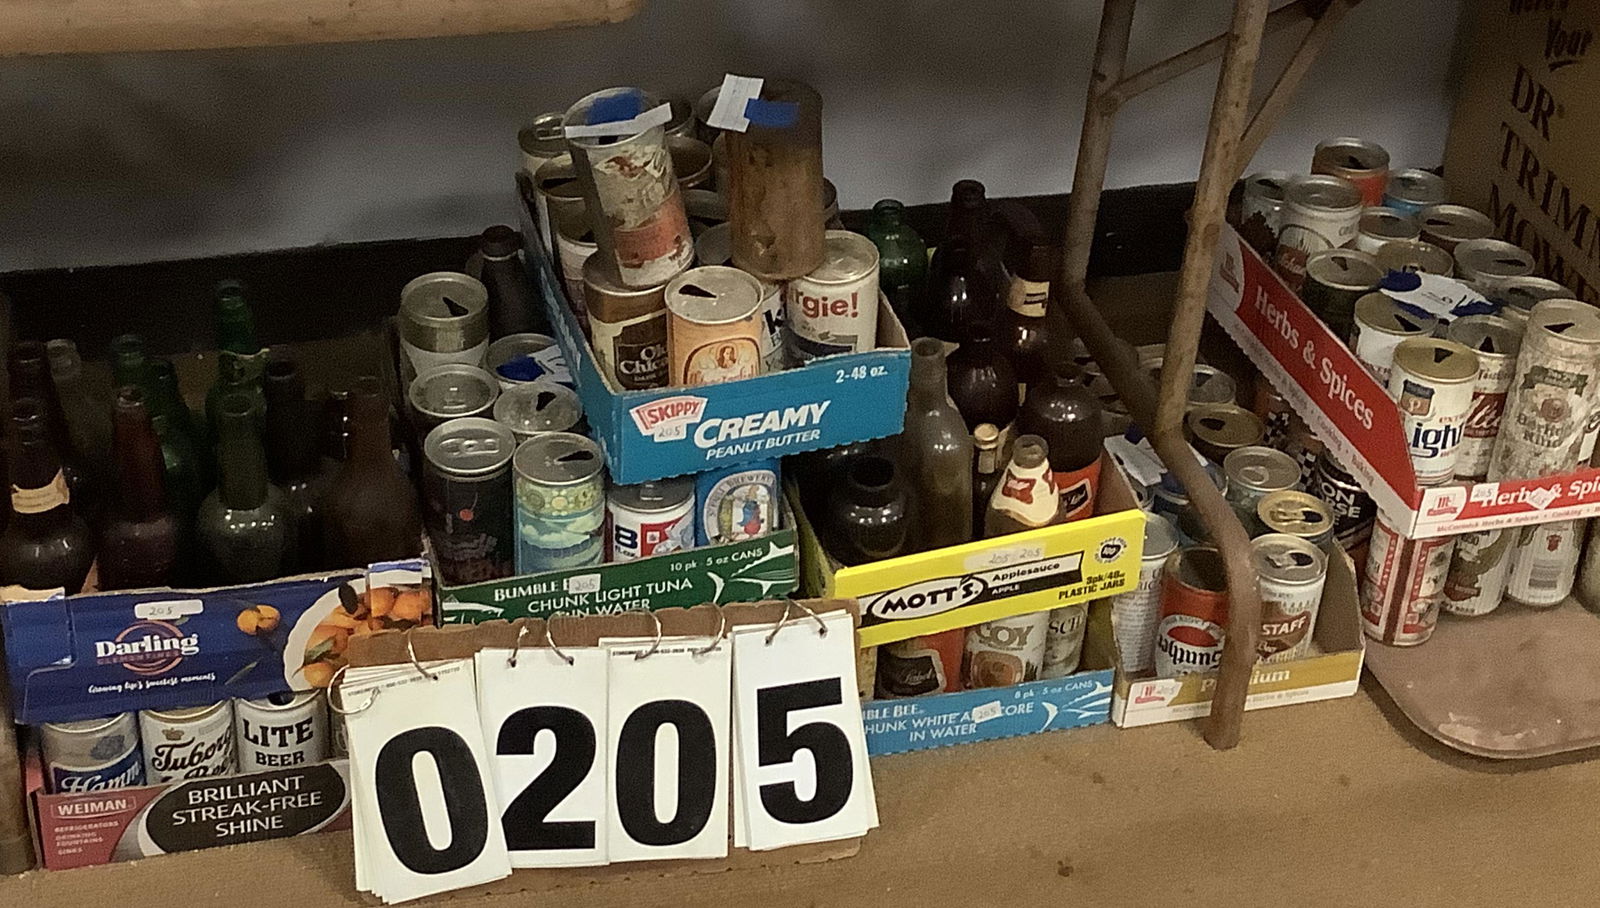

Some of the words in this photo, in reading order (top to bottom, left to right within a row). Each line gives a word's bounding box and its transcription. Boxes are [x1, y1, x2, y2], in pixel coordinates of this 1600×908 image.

[1511, 63, 1555, 142] DR
[1254, 285, 1299, 349] Herbs
[1303, 340, 1316, 369] &
[1319, 357, 1374, 430] Spices
[835, 366, 867, 383] 2-48
[647, 400, 700, 425] SKIPPY
[658, 426, 681, 438] 205
[693, 400, 831, 449] CREAMY
[705, 438, 766, 460] PEANUT
[765, 429, 821, 449] BUTTER
[1411, 422, 1464, 459] ight
[1482, 485, 1534, 508] Herb
[1568, 476, 1600, 501] Spi
[615, 525, 638, 549] 8
[670, 562, 682, 571] 10
[685, 560, 697, 572] pk
[706, 557, 713, 566] 5
[716, 556, 729, 565] oz
[731, 547, 763, 562] CANS
[1019, 548, 1041, 559] 205
[992, 562, 1060, 582] Applesauce
[494, 580, 559, 602] BUMBLE
[528, 593, 590, 613] CHUNK
[595, 585, 643, 603] LIGHT
[646, 578, 693, 595] TUNA
[573, 580, 596, 591] 205
[992, 584, 1020, 595] APPLE
[1059, 585, 1097, 600] PLASTIC
[1100, 578, 1125, 590] JARS
[149, 606, 174, 616] 205
[1262, 616, 1307, 636] STAFF
[94, 633, 200, 658] Darling
[88, 681, 122, 693] Growing
[181, 672, 216, 683] moments
[1023, 689, 1034, 700] pk
[1043, 687, 1049, 696] 5
[1064, 680, 1093, 692] CANS
[242, 716, 314, 748] LITE
[866, 720, 907, 735] HUNK
[911, 713, 958, 729] WHITE
[909, 730, 925, 743] IN
[929, 723, 977, 740] WATER
[255, 751, 305, 767] BEER
[188, 775, 305, 805] BRILLIANT
[57, 799, 127, 816] WEIMAN
[172, 791, 323, 826] STREAK-FREE
[215, 816, 285, 838] SHINE
